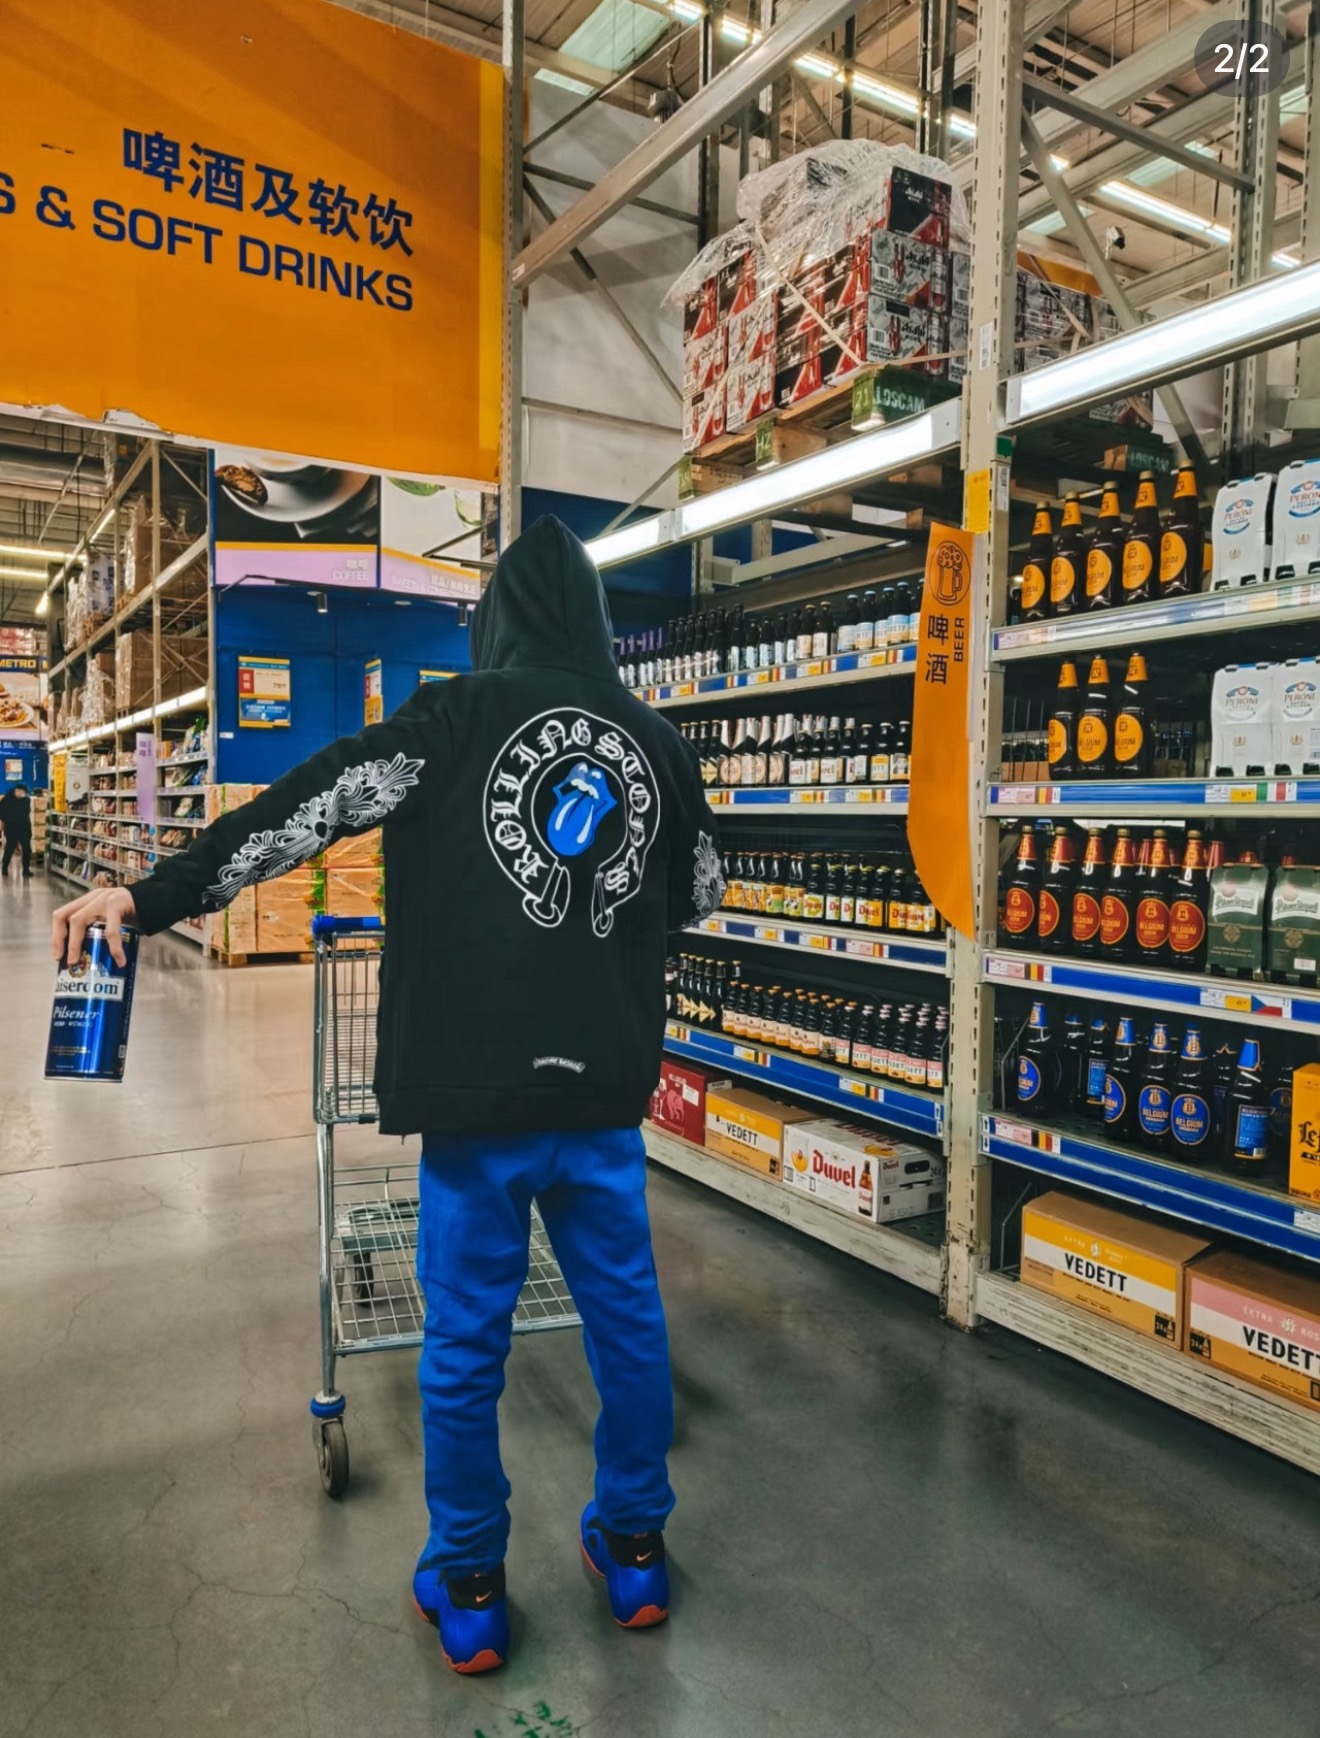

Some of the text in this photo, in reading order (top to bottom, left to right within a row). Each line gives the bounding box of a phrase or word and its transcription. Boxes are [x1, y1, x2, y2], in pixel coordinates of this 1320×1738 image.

[123, 128, 414, 257] 啤酒及软饮
[36, 185, 76, 230] &
[93, 199, 223, 264] SOFT
[239, 236, 414, 312] DRINKS
[333, 570, 370, 581] COFFEE
[925, 614, 950, 685] 啤酒
[953, 617, 965, 662] BEER
[726, 1122, 759, 1146] VEDETT
[1175, 1116, 1204, 1129] BELGIUM
[812, 1149, 856, 1189] Duvel
[1064, 1252, 1128, 1292] VEDETT
[1243, 1304, 1274, 1324] EXTRA
